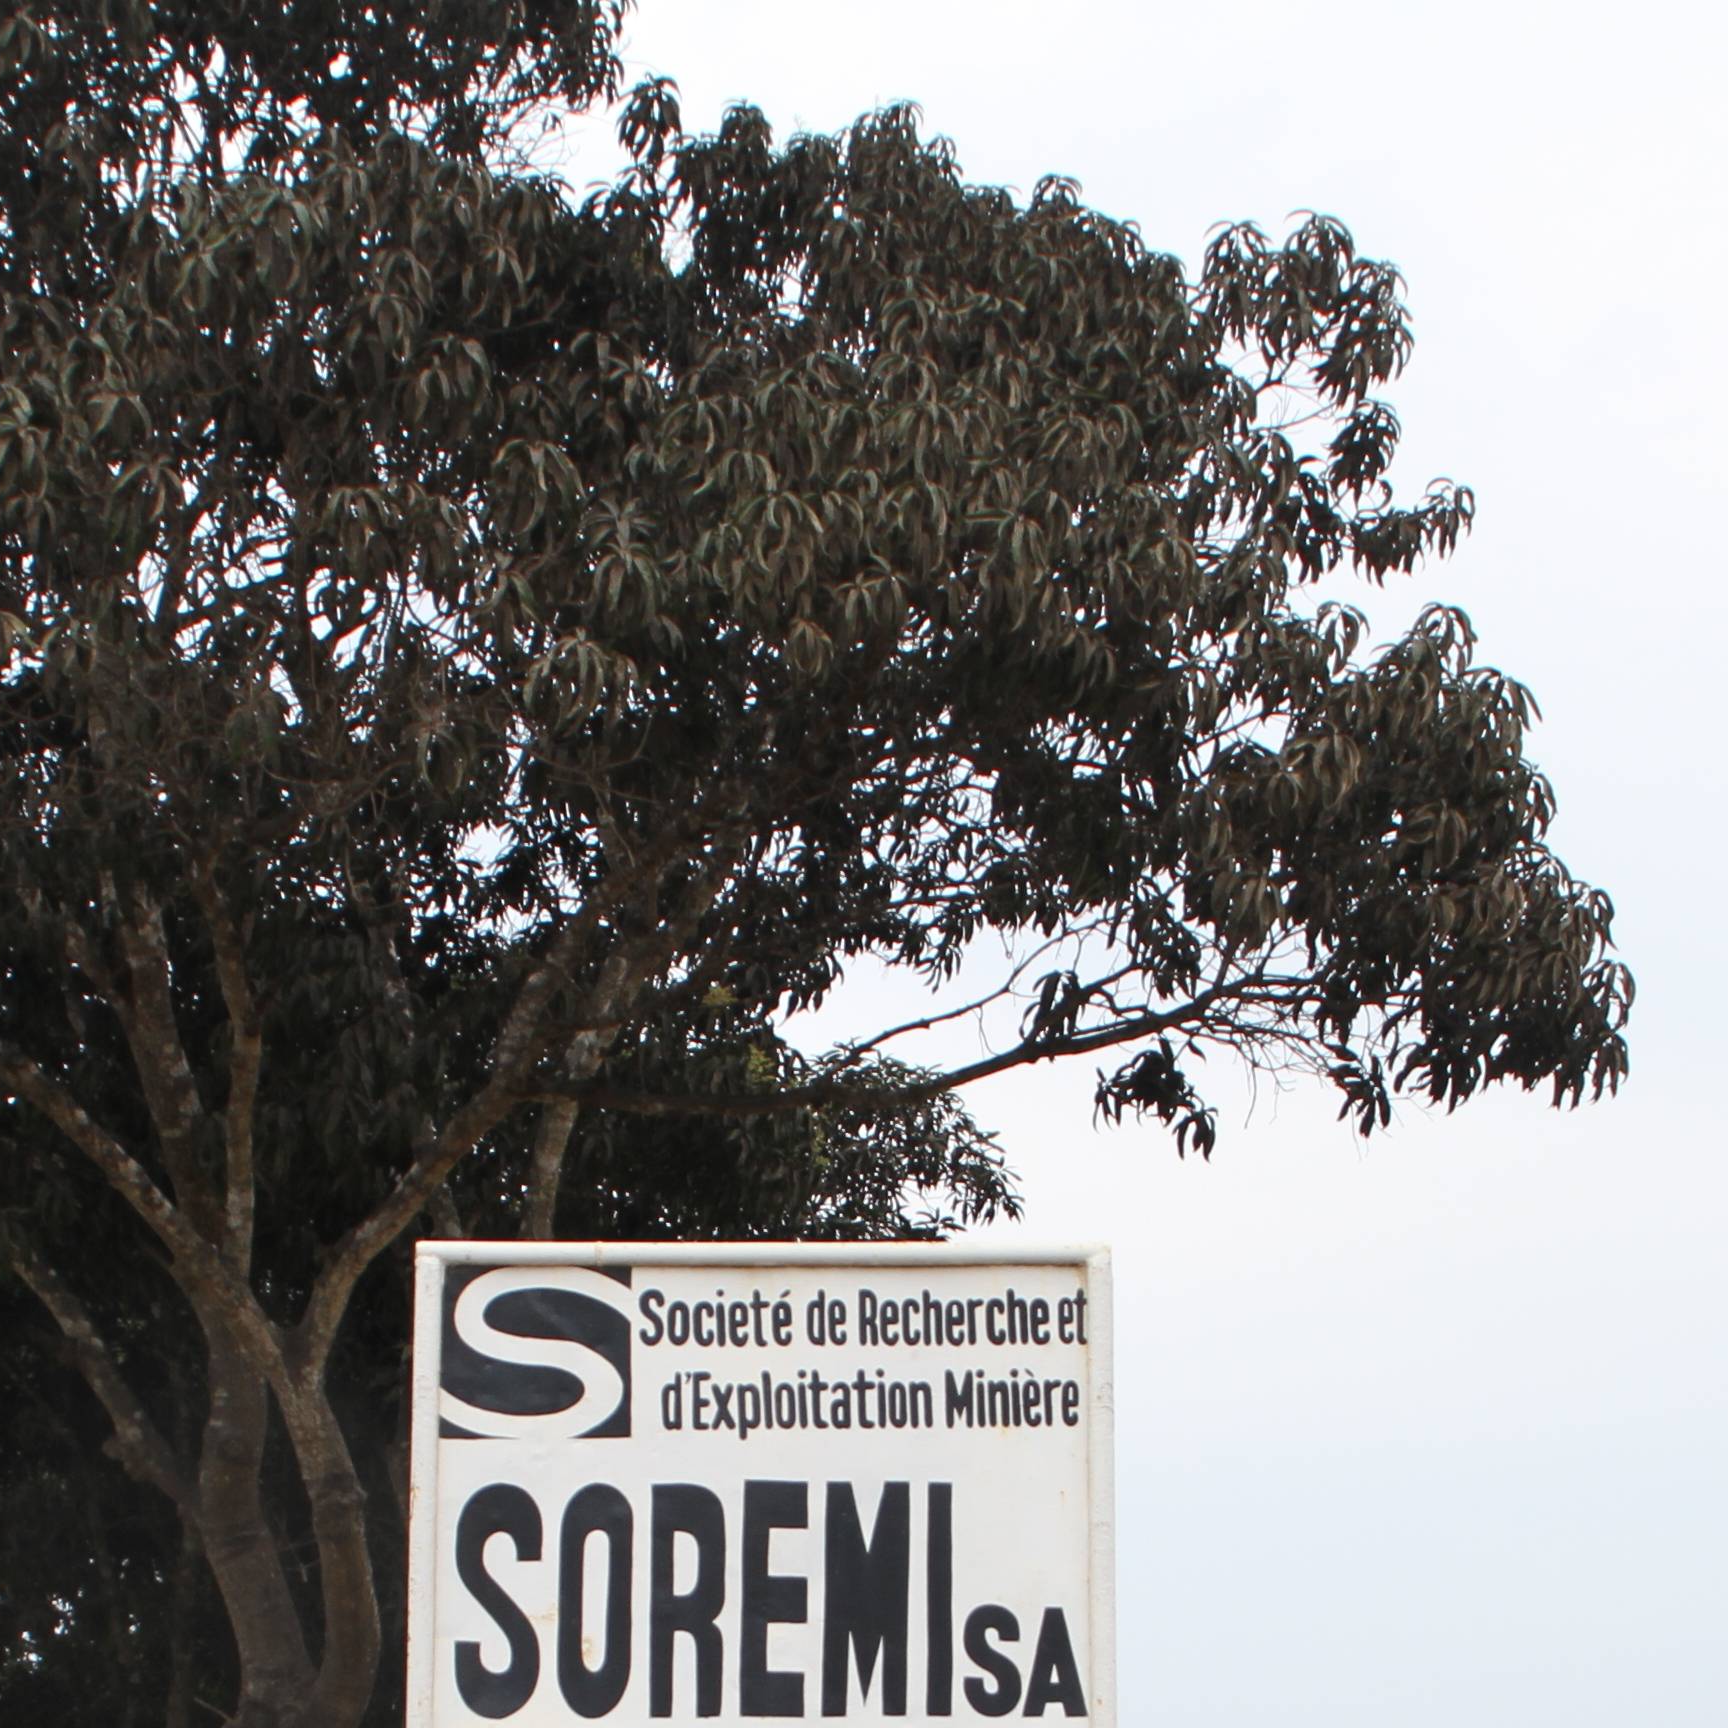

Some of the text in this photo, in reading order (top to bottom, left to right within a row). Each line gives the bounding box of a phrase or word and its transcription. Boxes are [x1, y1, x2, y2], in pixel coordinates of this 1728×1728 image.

[639, 1288, 1087, 1346] Societé de Recherche et
[661, 1369, 1079, 1439] d'Exploitation Minière
[454, 1480, 1087, 1719] SOREMI SA
